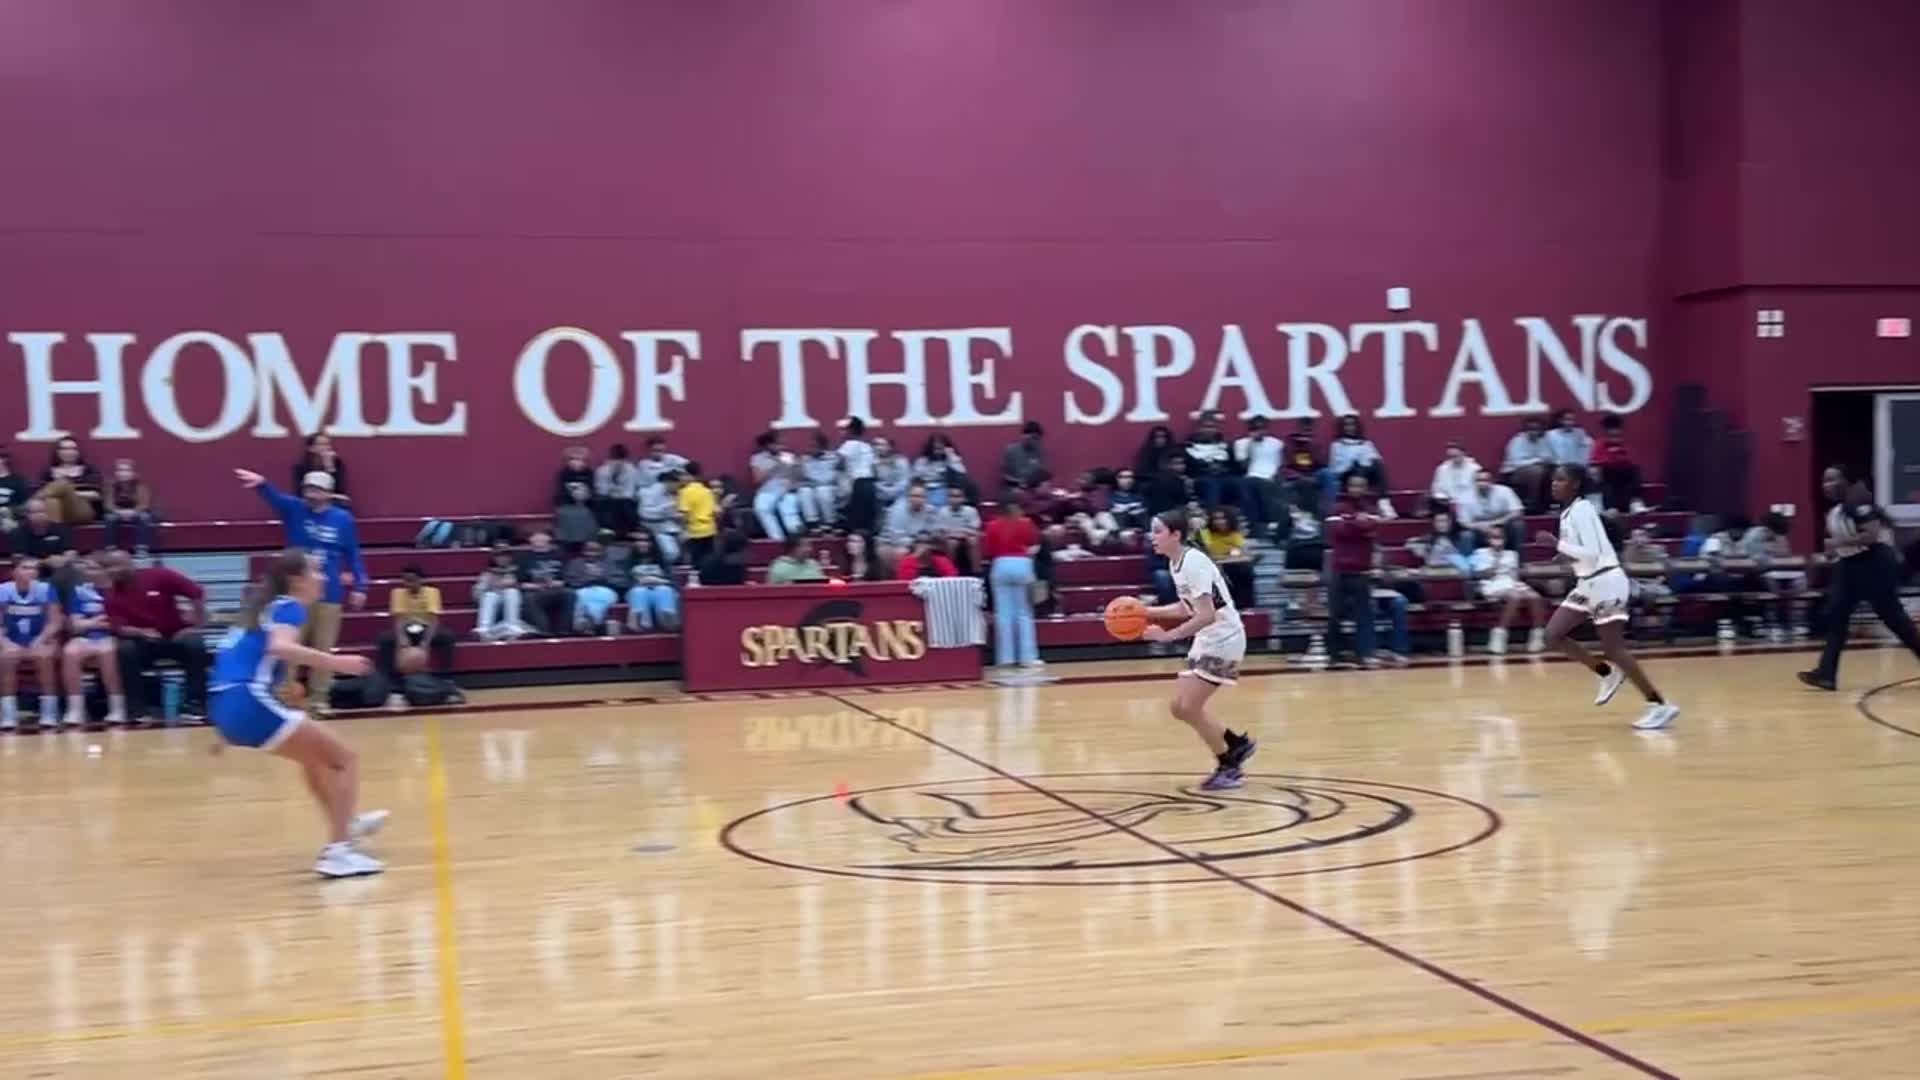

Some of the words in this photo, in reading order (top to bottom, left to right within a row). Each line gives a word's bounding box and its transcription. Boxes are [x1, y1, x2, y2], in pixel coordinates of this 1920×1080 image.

[8, 330, 468, 443] HOME
[513, 326, 701, 437] OF
[741, 325, 1023, 430] THE
[1063, 315, 1652, 427] SPARTANS
[740, 619, 925, 668] SPARTANS
